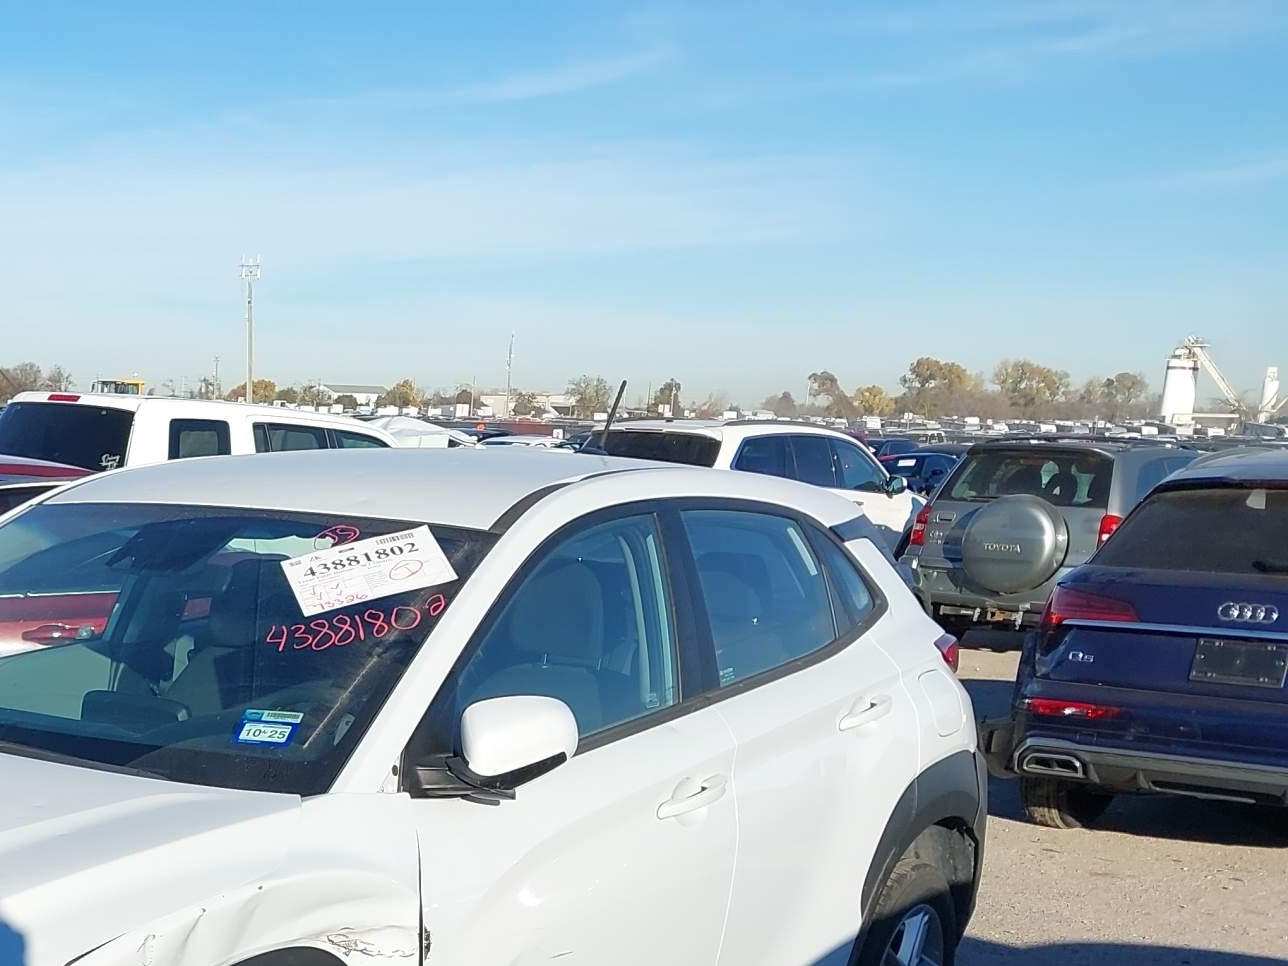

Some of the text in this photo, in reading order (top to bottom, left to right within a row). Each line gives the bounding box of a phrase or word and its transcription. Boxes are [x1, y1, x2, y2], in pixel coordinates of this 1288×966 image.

[303, 542, 420, 578] 43881802
[983, 542, 1022, 553] TOYOTA
[266, 593, 446, 653] 43881802
